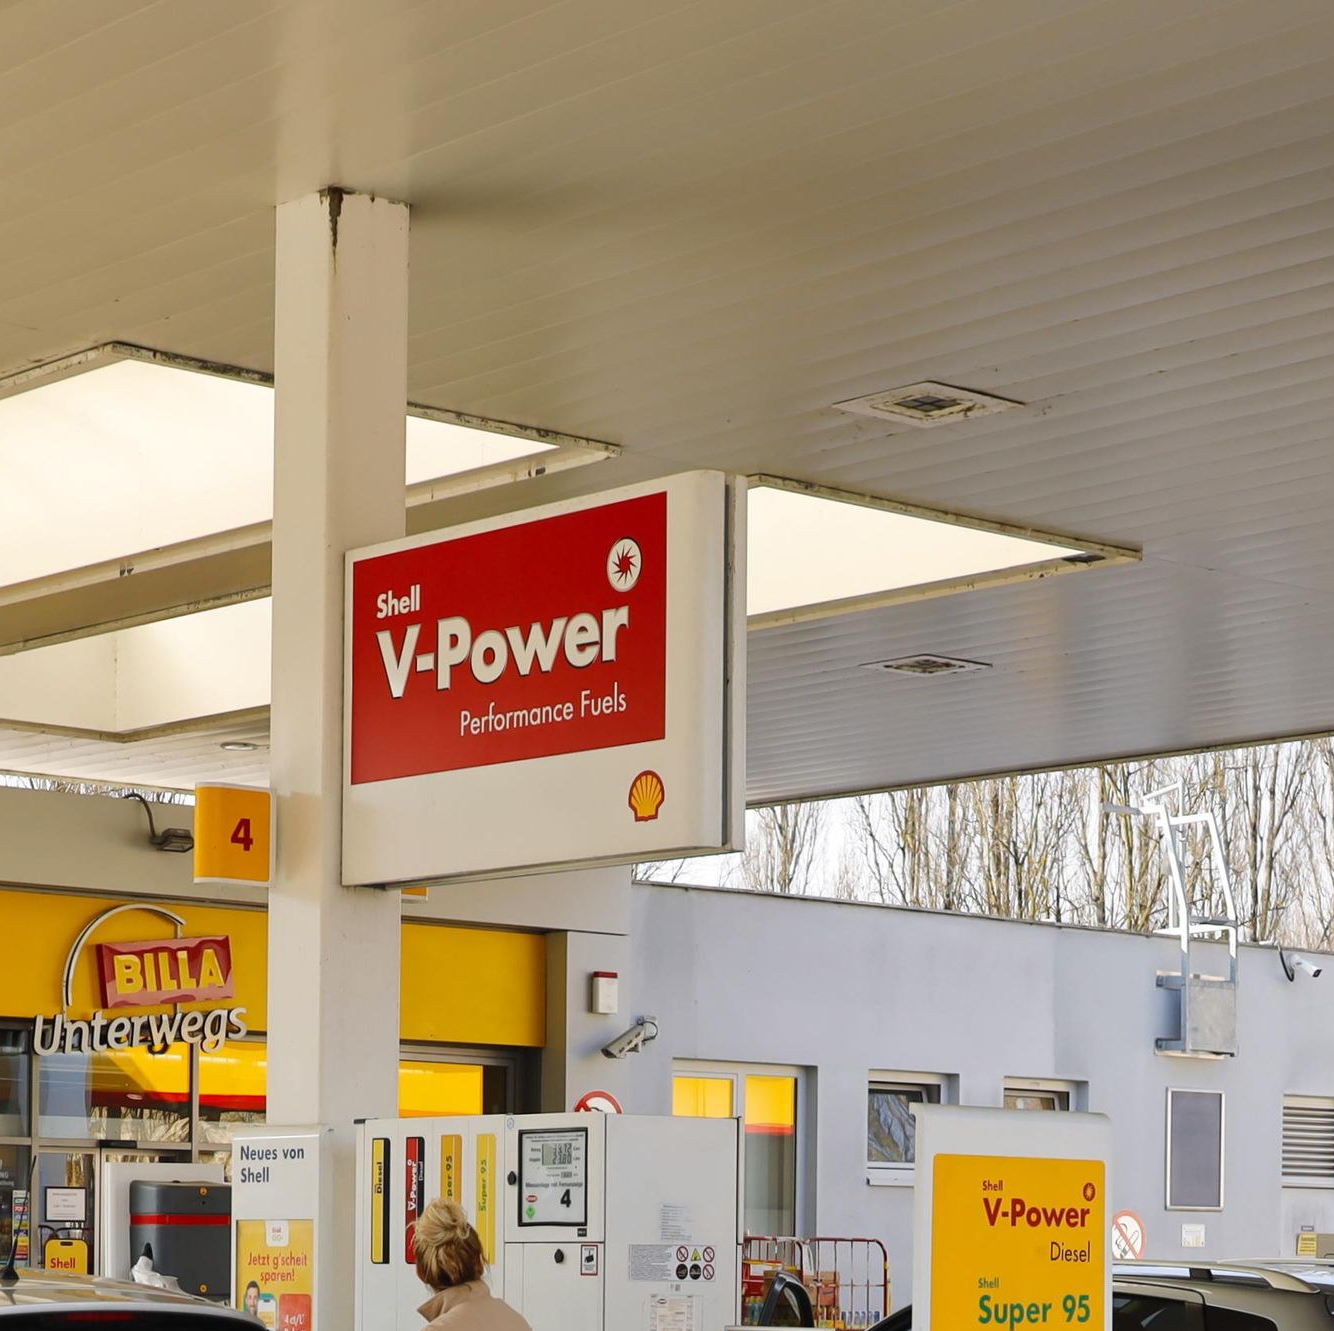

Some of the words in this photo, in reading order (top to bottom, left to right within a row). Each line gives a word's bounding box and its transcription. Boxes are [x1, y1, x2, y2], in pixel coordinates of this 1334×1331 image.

[376, 584, 421, 619] Shell
[376, 605, 629, 699] V-Power
[460, 702, 573, 736] Performance
[580, 681, 627, 718] Fuels
[230, 818, 254, 852] 4
[113, 948, 225, 994] BILLA
[32, 1007, 247, 1056] Unterwegs
[240, 1145, 278, 1161] Neues
[283, 1147, 304, 1159] von
[240, 1166, 269, 1183] Shell
[982, 1180, 1003, 1191] Shell
[560, 1189, 571, 1208] 4
[983, 1198, 1090, 1228] V-Power
[247, 1252, 270, 1266] Jetzt
[1050, 1241, 1090, 1262] Diesel
[50, 1257, 76, 1269] Shell
[260, 1270, 295, 1284] sparen!
[978, 1277, 999, 1288] Shell
[978, 1294, 1052, 1331] Super
[1062, 1294, 1090, 1322] 95
